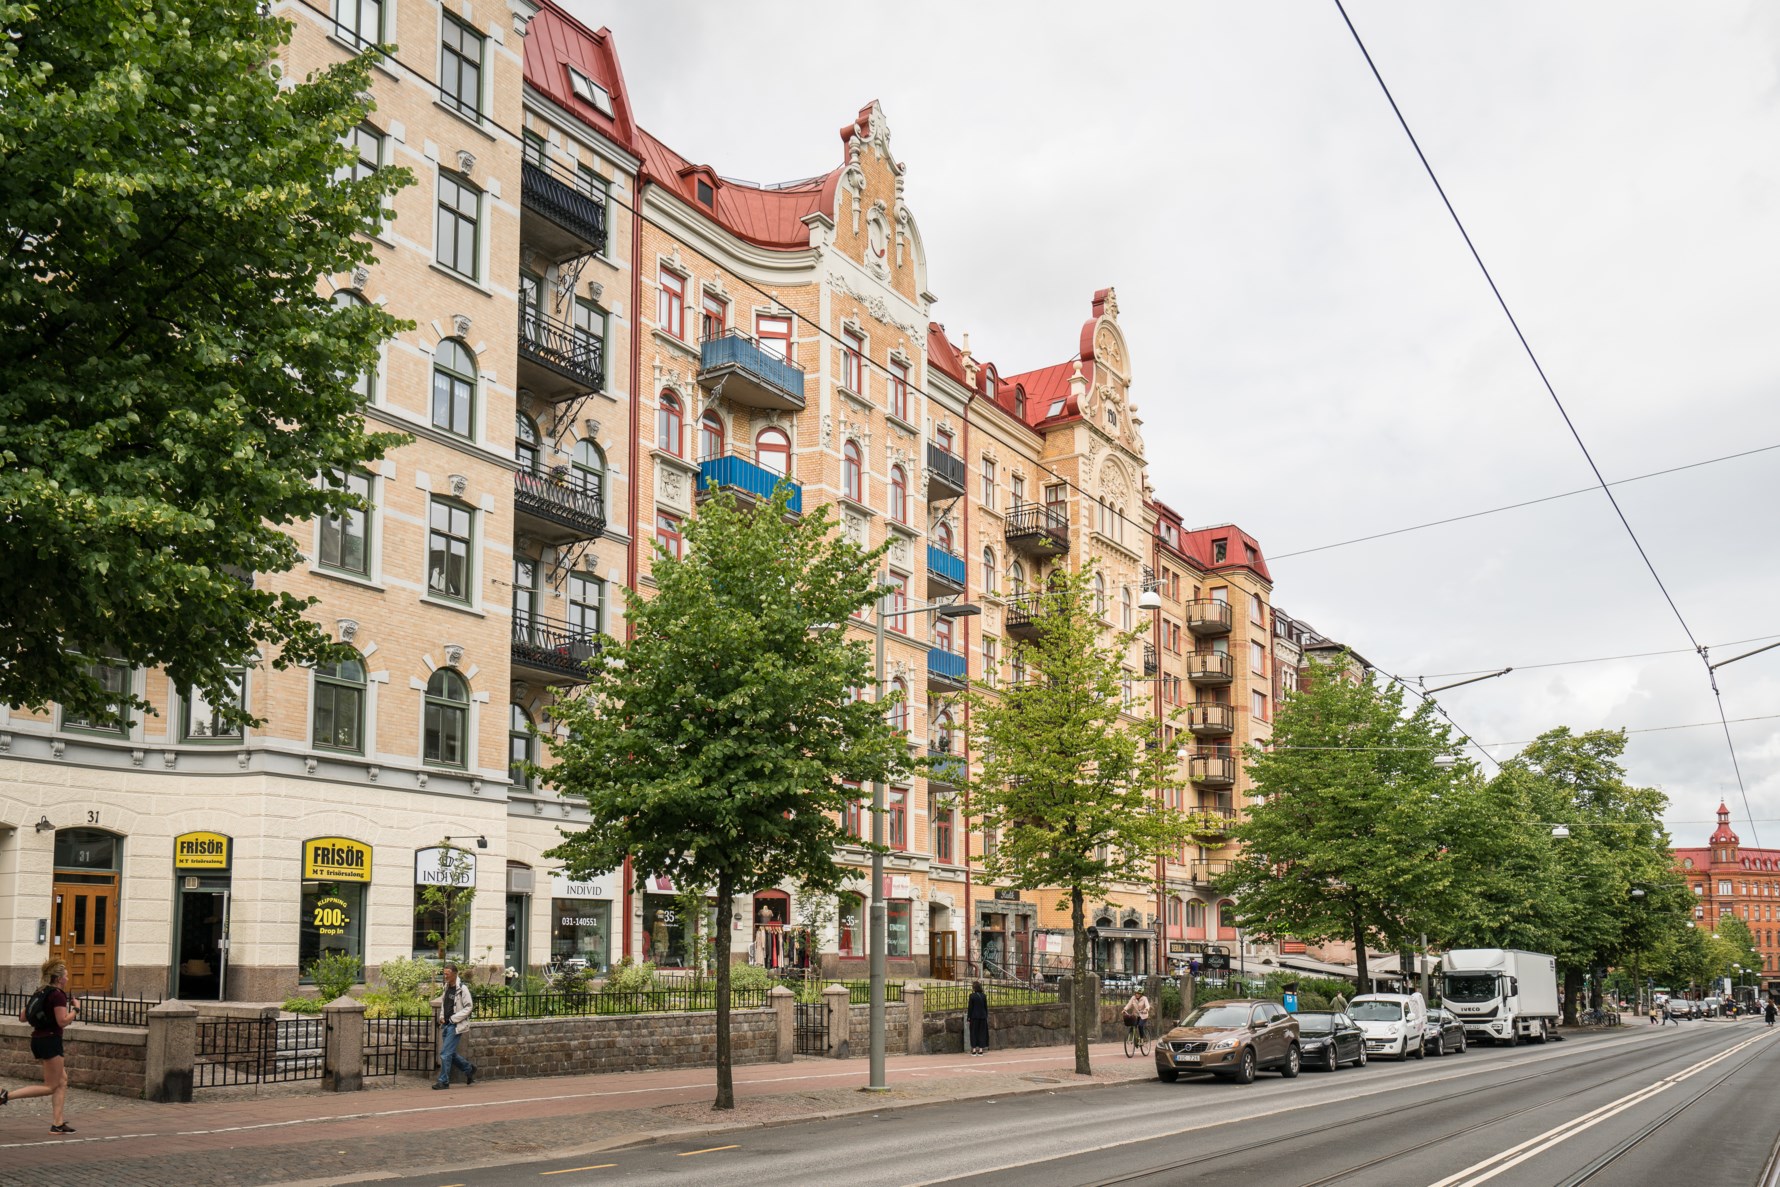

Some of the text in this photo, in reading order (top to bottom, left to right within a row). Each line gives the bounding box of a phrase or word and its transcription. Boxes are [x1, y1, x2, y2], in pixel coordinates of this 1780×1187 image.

[87, 810, 100, 823] 31
[80, 850, 90, 862] 31
[326, 870, 365, 879] frisörsalong
[423, 870, 470, 884] INDIVID
[566, 885, 602, 896] INDIVID
[317, 897, 348, 908] KLIPPNING
[313, 908, 350, 926] 200:-
[561, 917, 597, 926] 031-140551
[664, 910, 675, 923] 35
[846, 915, 855, 926] 35
[319, 927, 344, 936] Drop In
